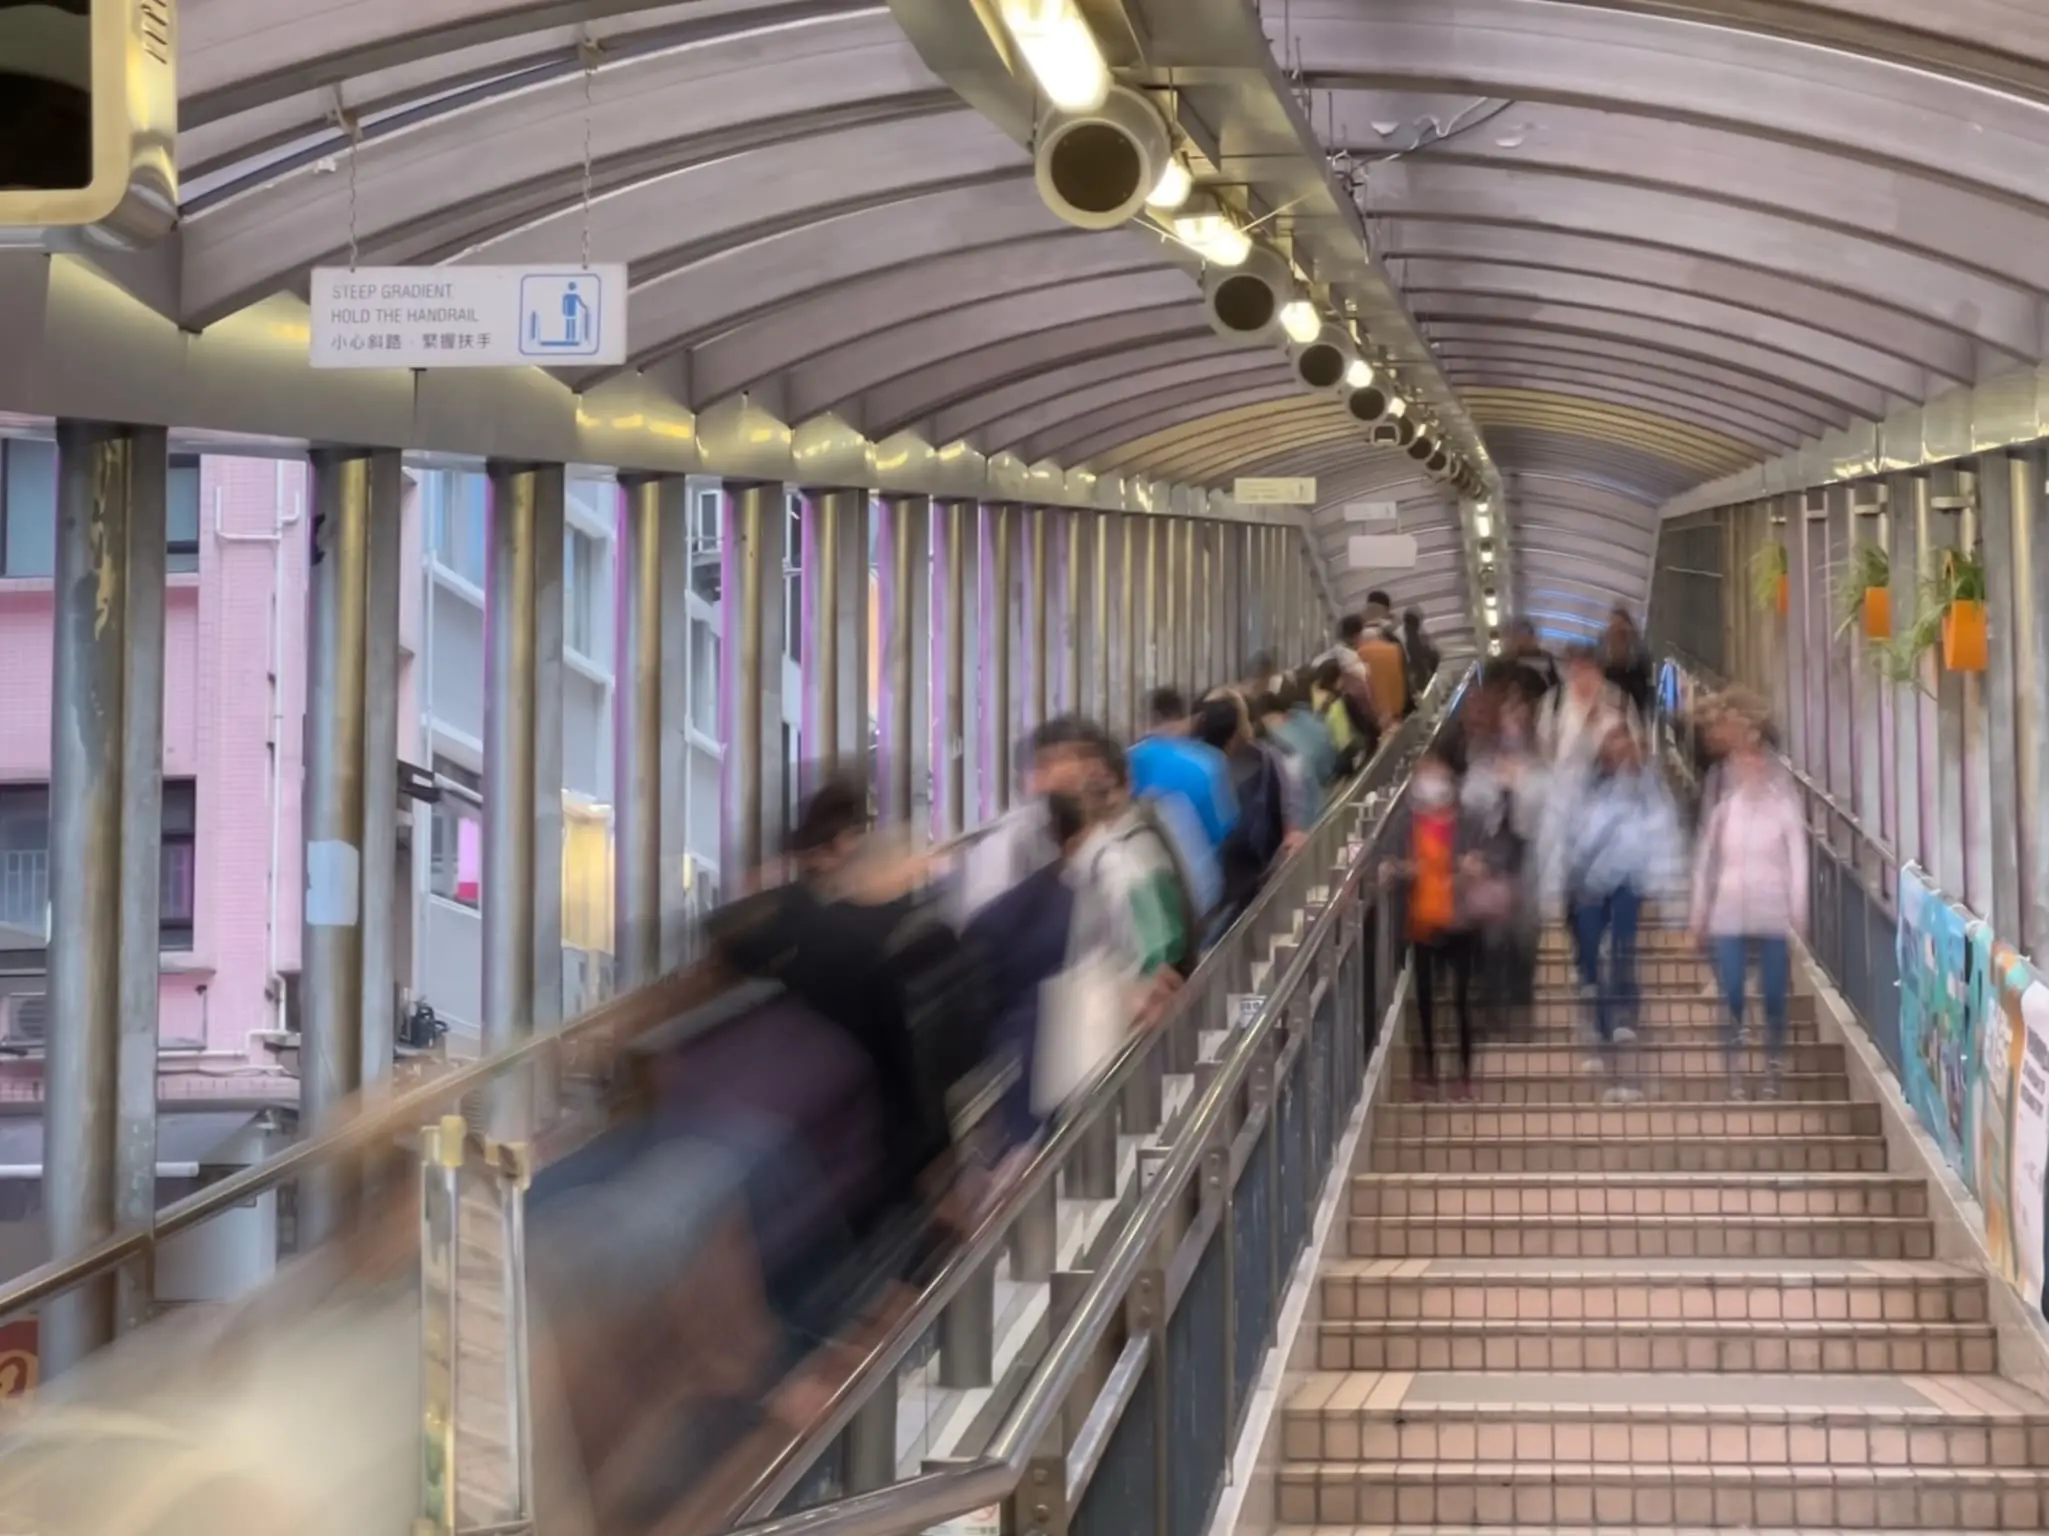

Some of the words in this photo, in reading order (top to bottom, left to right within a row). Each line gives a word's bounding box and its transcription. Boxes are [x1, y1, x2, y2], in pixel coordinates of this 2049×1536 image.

[331, 283, 377, 300] STEEP
[381, 283, 453, 299] GRADIENT
[331, 308, 371, 324] HOLD
[376, 308, 401, 324] THE
[406, 307, 479, 323] HANDRAIL
